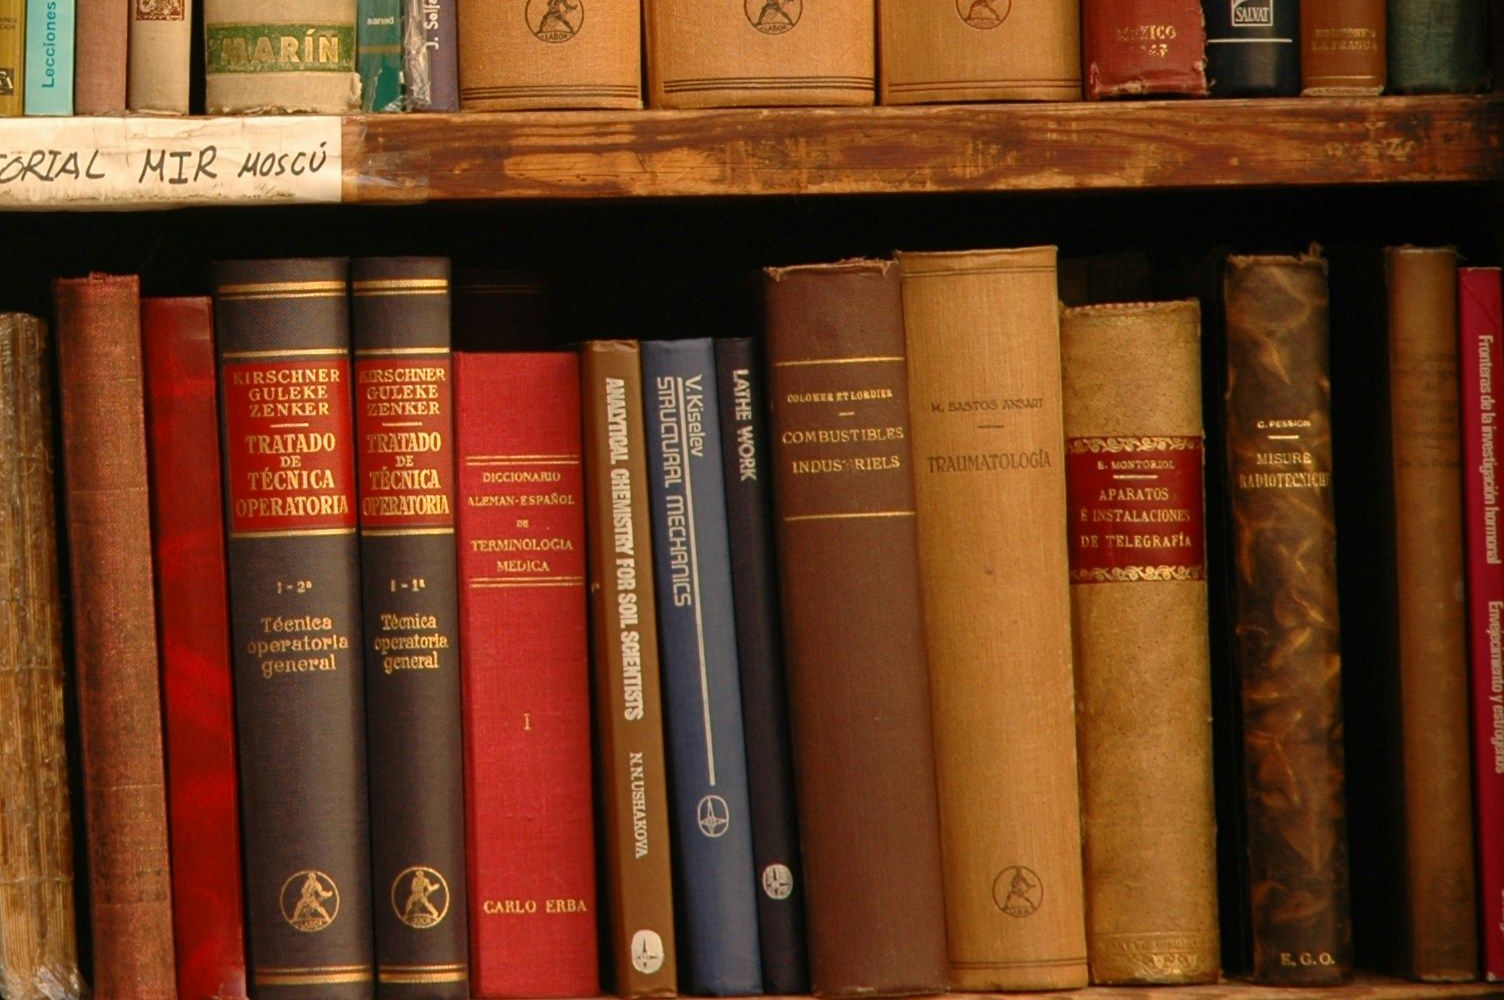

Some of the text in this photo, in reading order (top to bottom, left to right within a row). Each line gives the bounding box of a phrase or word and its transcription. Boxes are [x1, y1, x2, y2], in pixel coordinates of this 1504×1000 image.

[1235, 7, 1270, 23] SALVAT
[42, 1, 56, 89] Lecciones
[220, 28, 339, 64] MARÍN
[139, 147, 218, 186] MIR
[237, 141, 328, 179] MOSCÚ
[1478, 334, 1493, 394] Fronteras
[233, 368, 340, 385] KIRSCHNER
[358, 368, 446, 383] KIRSCHNER
[248, 385, 329, 401] GULEKE
[366, 385, 438, 400] GULEKE
[249, 402, 330, 418] ZENKER
[367, 401, 441, 417] ZENKER
[948, 400, 998, 412] BASTOS
[732, 369, 757, 482] LATHE WORK
[244, 432, 337, 454] TRATADO
[367, 432, 442, 453] TRATADO
[782, 427, 905, 445] COMBUSTIBLES
[605, 377, 634, 554] ANALYTICAL CHEMISTRY
[1110, 459, 1176, 470] MONTORIOL
[1256, 453, 1312, 466] MISURE
[247, 466, 335, 490] TÉCNICA
[369, 467, 442, 490] TÉCNICA
[482, 472, 561, 484] DICCIONARIO
[467, 492, 575, 507] ALEMAN-ESPAÑOL
[656, 376, 691, 608] STRUCTURAL MECHANICS
[1098, 487, 1169, 502] APARATOS
[236, 493, 349, 517] OPERATORIA
[362, 494, 450, 516] OPERATORIA
[471, 540, 573, 551] TERMINOLOGIA
[1105, 532, 1192, 549] TELEGRAFÍA
[496, 560, 551, 572] MEDICA
[260, 615, 333, 632] Técnica
[380, 614, 437, 631] Técnica
[247, 635, 349, 655] operatoria
[374, 634, 449, 652] operatoria
[261, 656, 338, 679] general
[383, 652, 439, 675] general
[483, 899, 587, 914] CARLO ERBA
